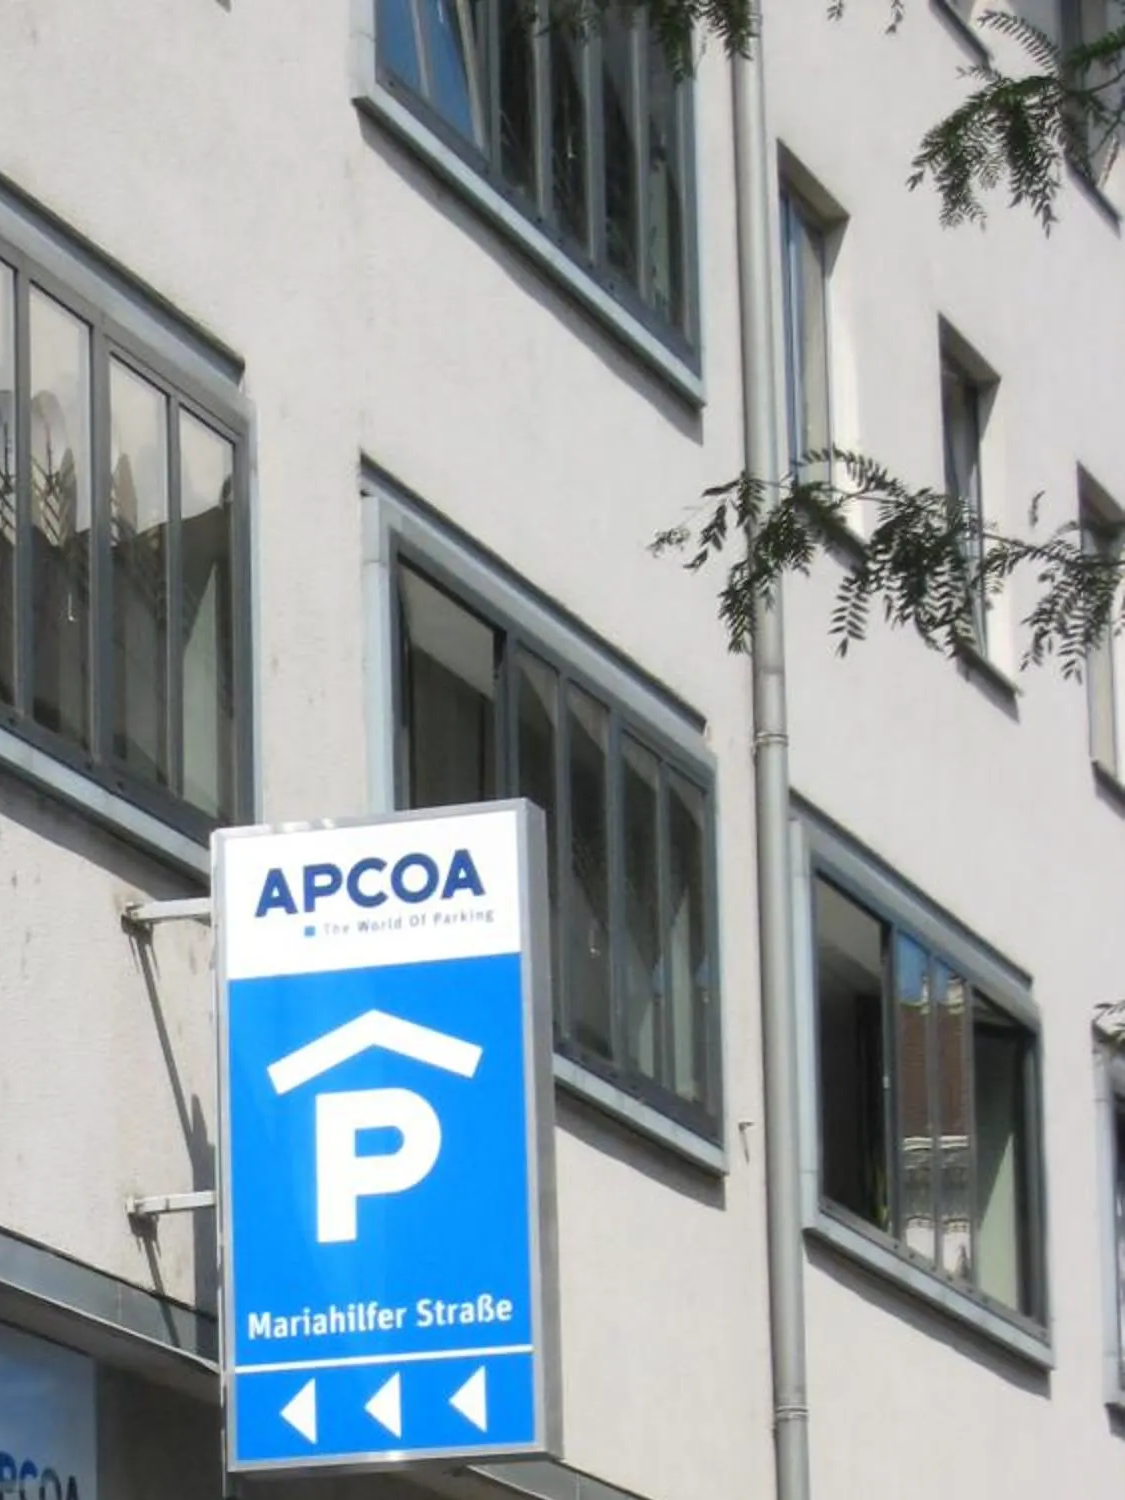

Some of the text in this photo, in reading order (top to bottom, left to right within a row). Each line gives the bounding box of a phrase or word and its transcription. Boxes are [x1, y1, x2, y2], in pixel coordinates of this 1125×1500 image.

[254, 848, 486, 918] APCOA
[323, 907, 495, 936] The World Of Parking
[315, 1087, 442, 1243] P
[247, 1293, 514, 1341] Mariahilfer Straße
